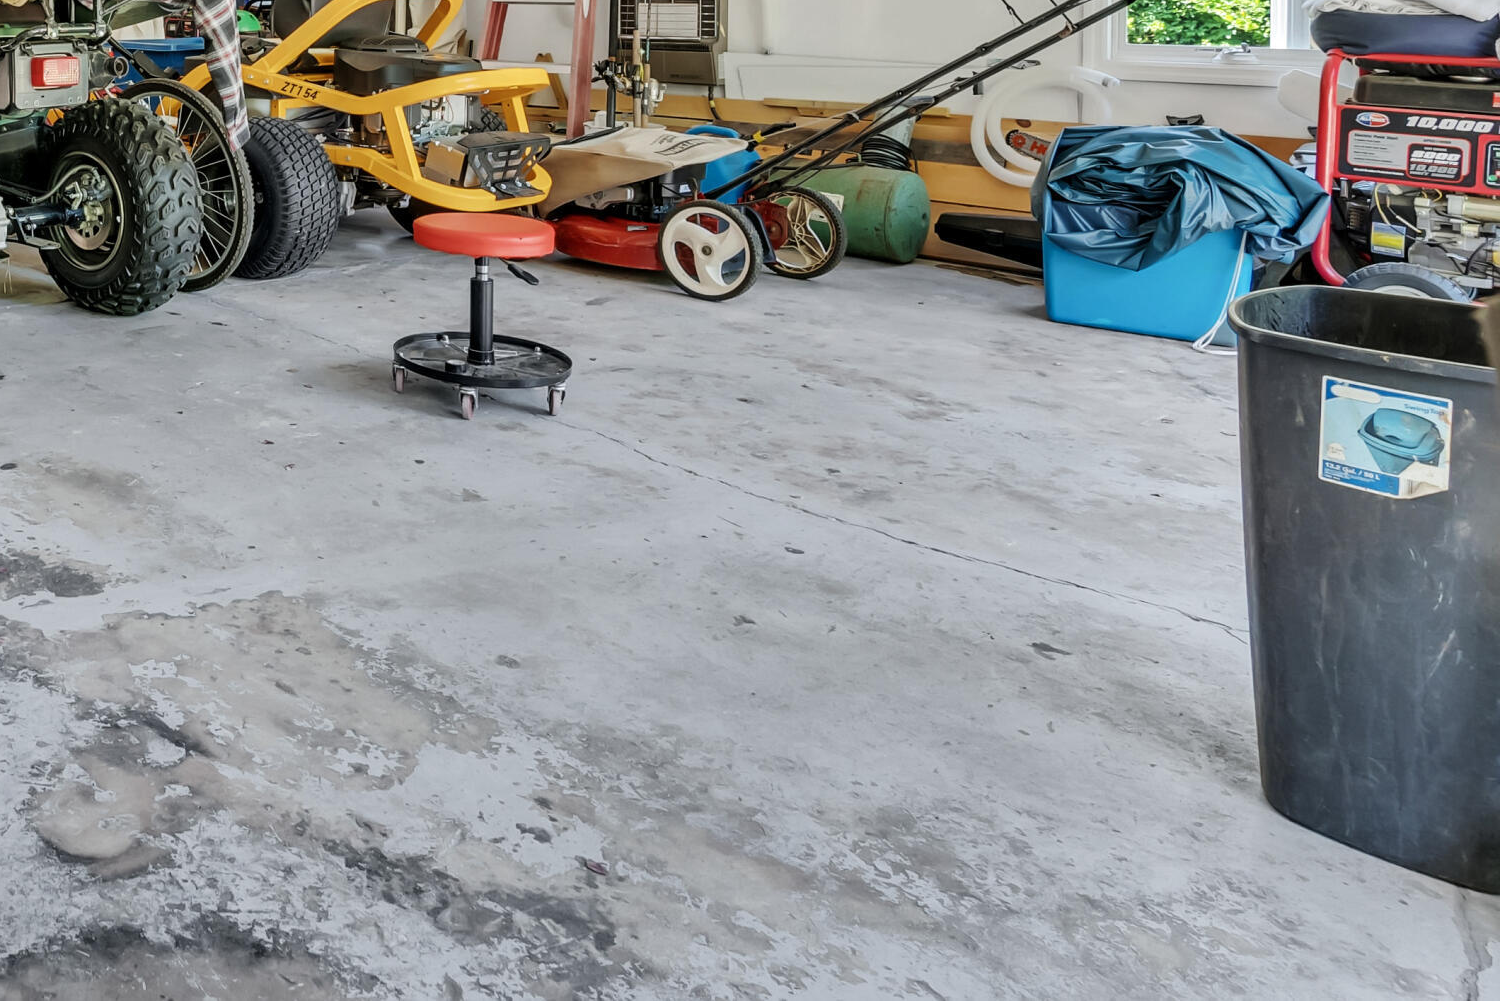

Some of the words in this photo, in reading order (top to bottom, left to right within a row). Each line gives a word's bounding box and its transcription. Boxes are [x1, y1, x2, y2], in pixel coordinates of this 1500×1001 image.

[280, 81, 303, 96] ZT1
[303, 88, 318, 100] 54
[1406, 115, 1494, 133] 10,000
